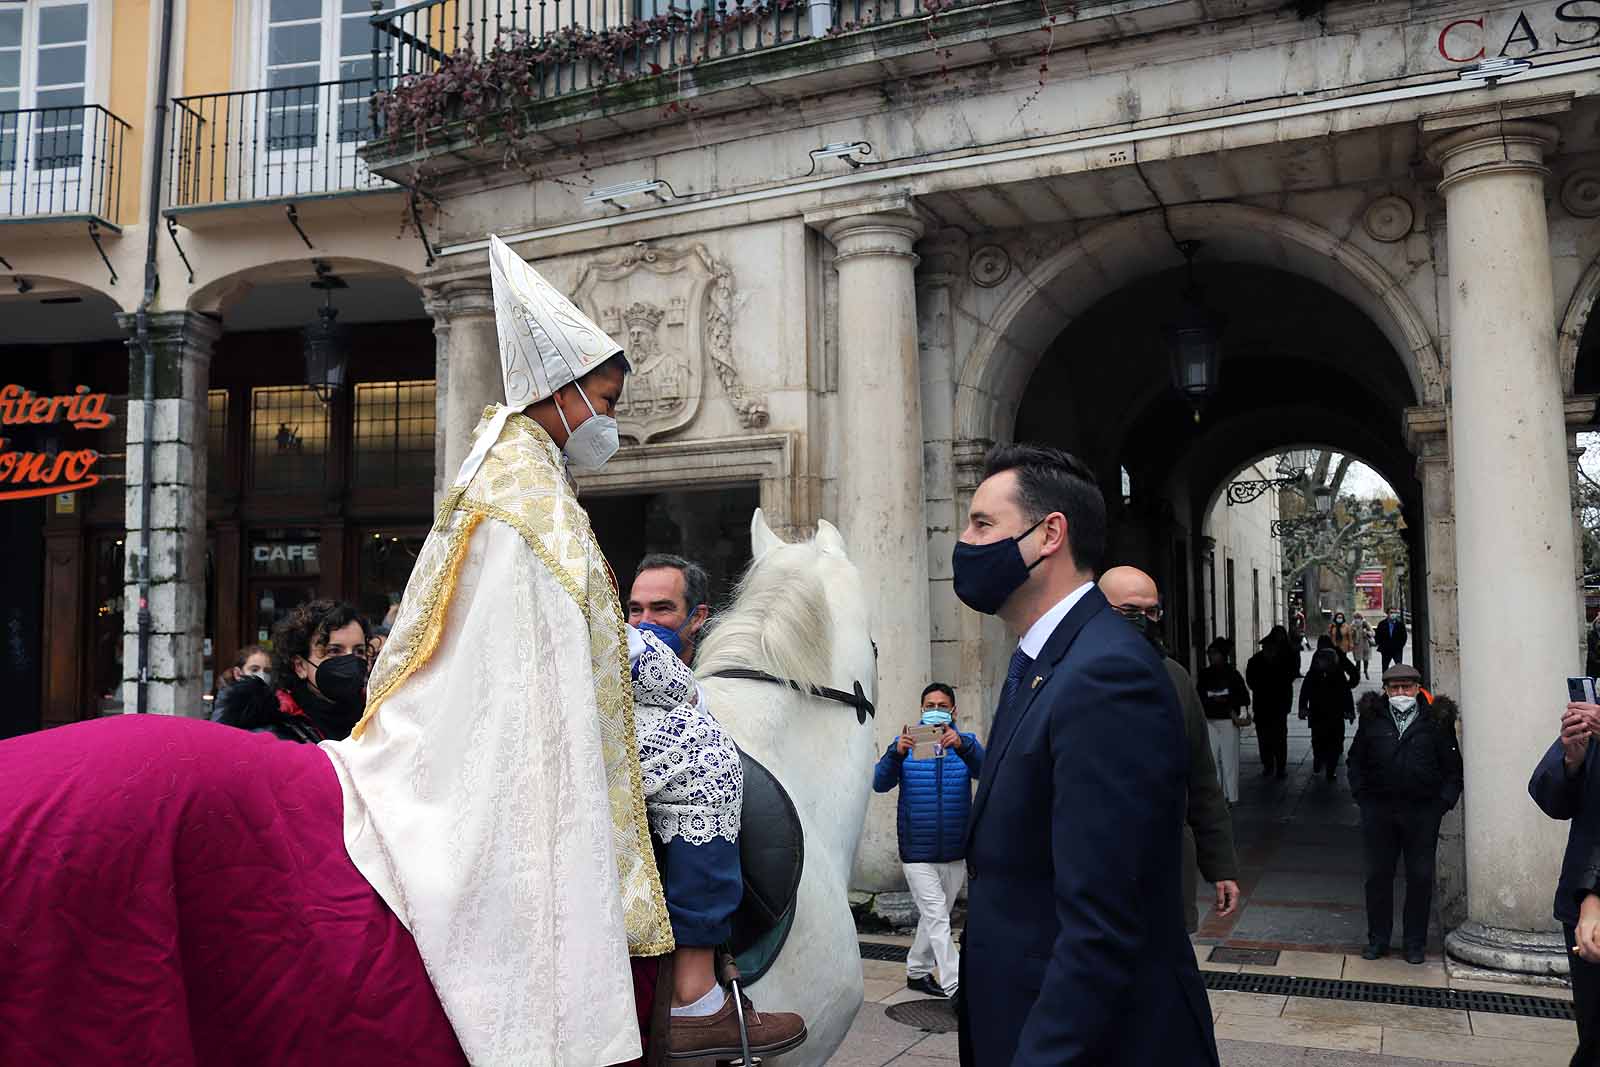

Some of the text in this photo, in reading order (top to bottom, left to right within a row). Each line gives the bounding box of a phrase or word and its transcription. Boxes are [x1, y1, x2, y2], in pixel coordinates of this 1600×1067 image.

[1438, 0, 1600, 62] CAS
[0, 444, 98, 488] onso
[253, 545, 318, 561] CAFE
